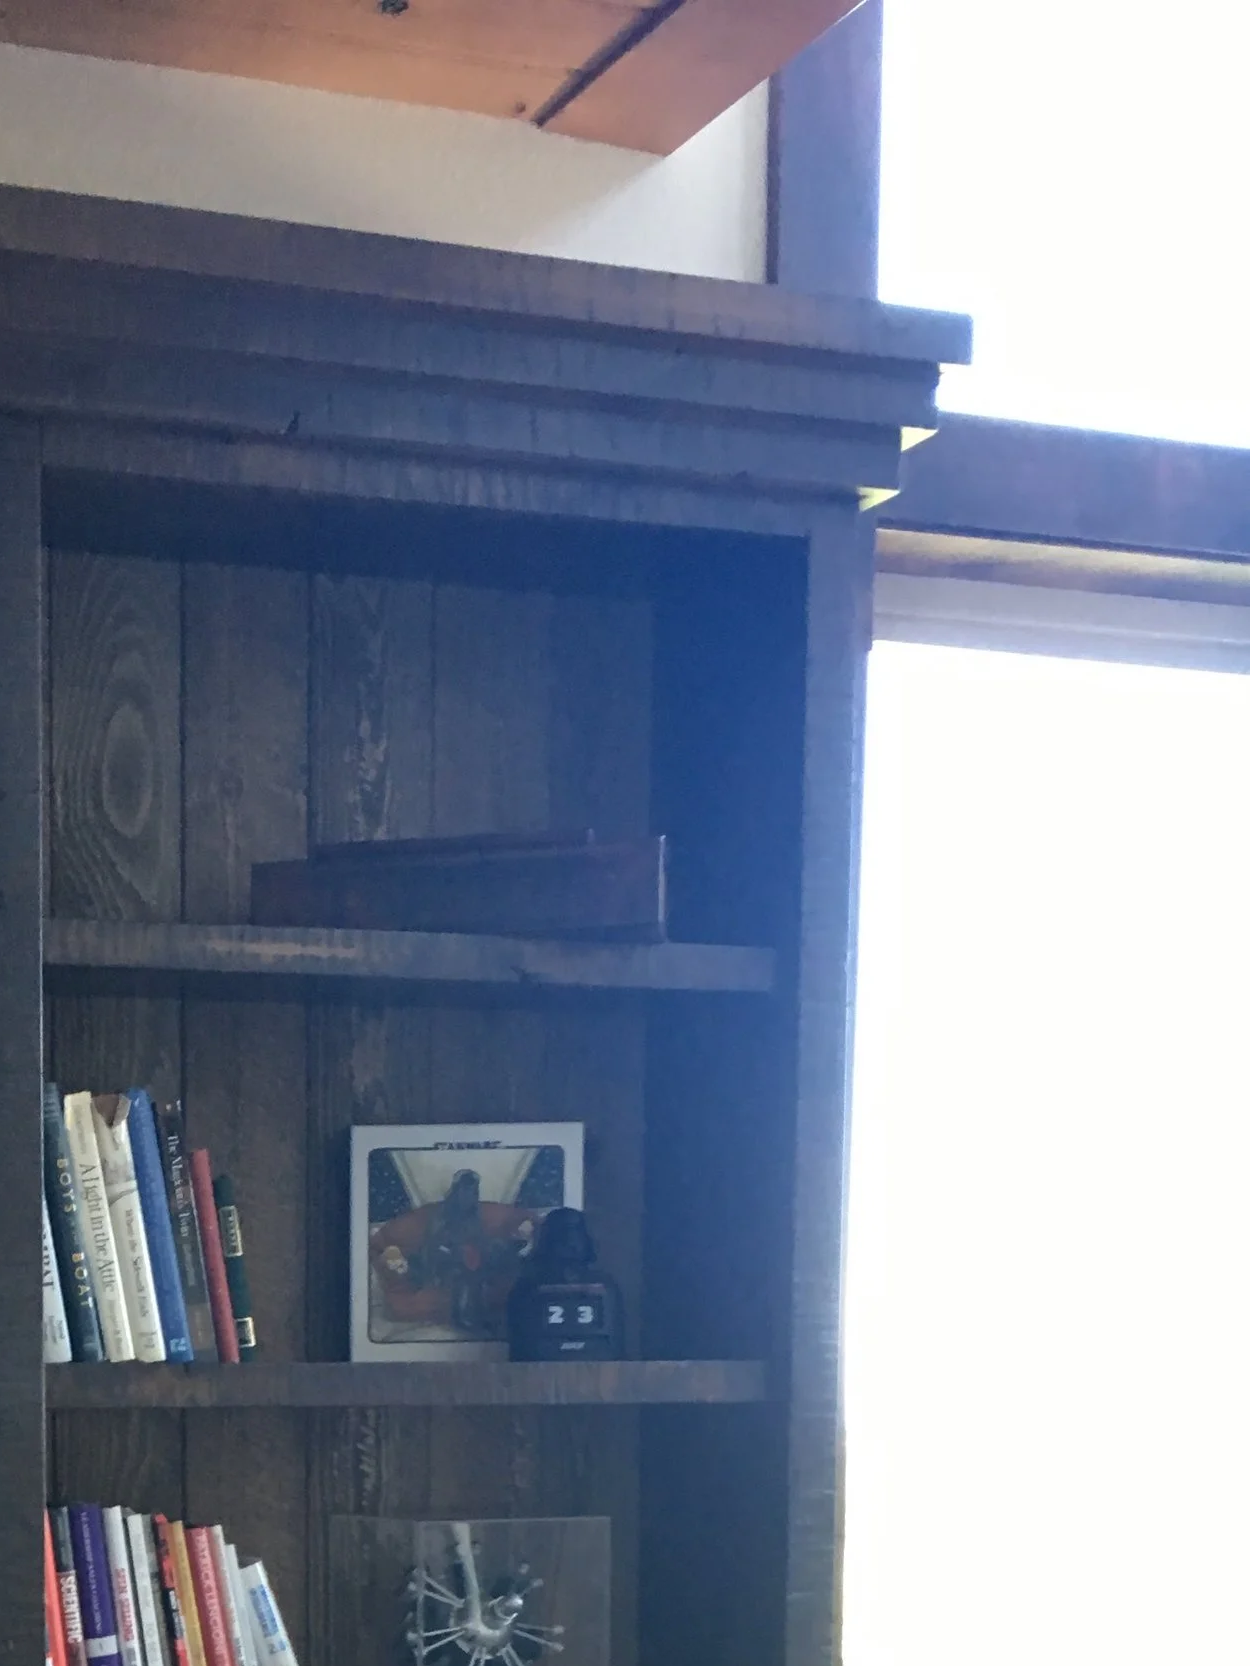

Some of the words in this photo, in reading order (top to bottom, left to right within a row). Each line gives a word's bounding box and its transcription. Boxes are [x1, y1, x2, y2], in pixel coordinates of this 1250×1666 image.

[79, 1163, 95, 1176] A
[81, 1176, 104, 1214] Light
[56, 1158, 77, 1213] BOYS
[71, 1252, 93, 1309] BOAT
[91, 1215, 105, 1232] in
[93, 1233, 109, 1257] the
[96, 1258, 116, 1293] Attic
[195, 1534, 216, 1586] PATRICK
[59, 1574, 83, 1644] SCIENTIFIC
